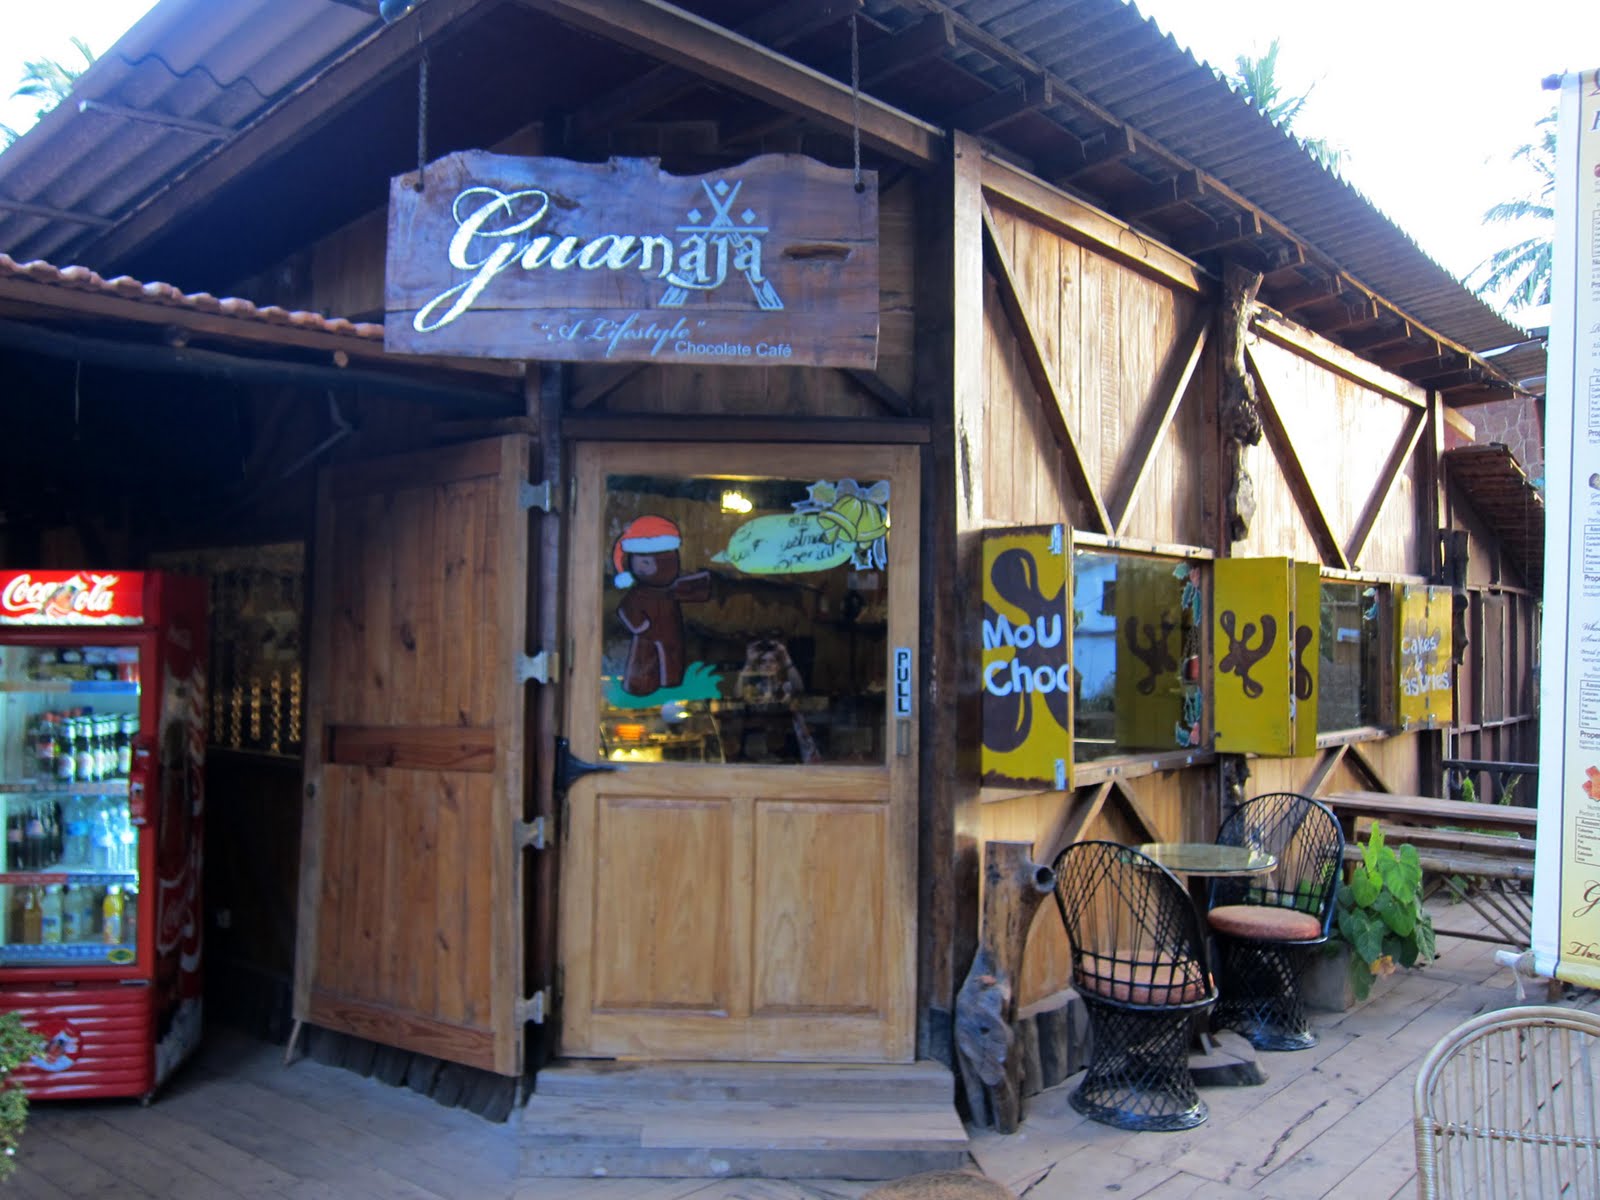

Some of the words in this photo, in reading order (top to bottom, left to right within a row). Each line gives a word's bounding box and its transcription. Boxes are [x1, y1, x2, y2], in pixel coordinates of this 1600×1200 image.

[674, 340, 752, 357] Chocolate
[756, 342, 793, 358] Café
[2, 573, 119, 612] Cocaola
[897, 651, 909, 713] PULL
